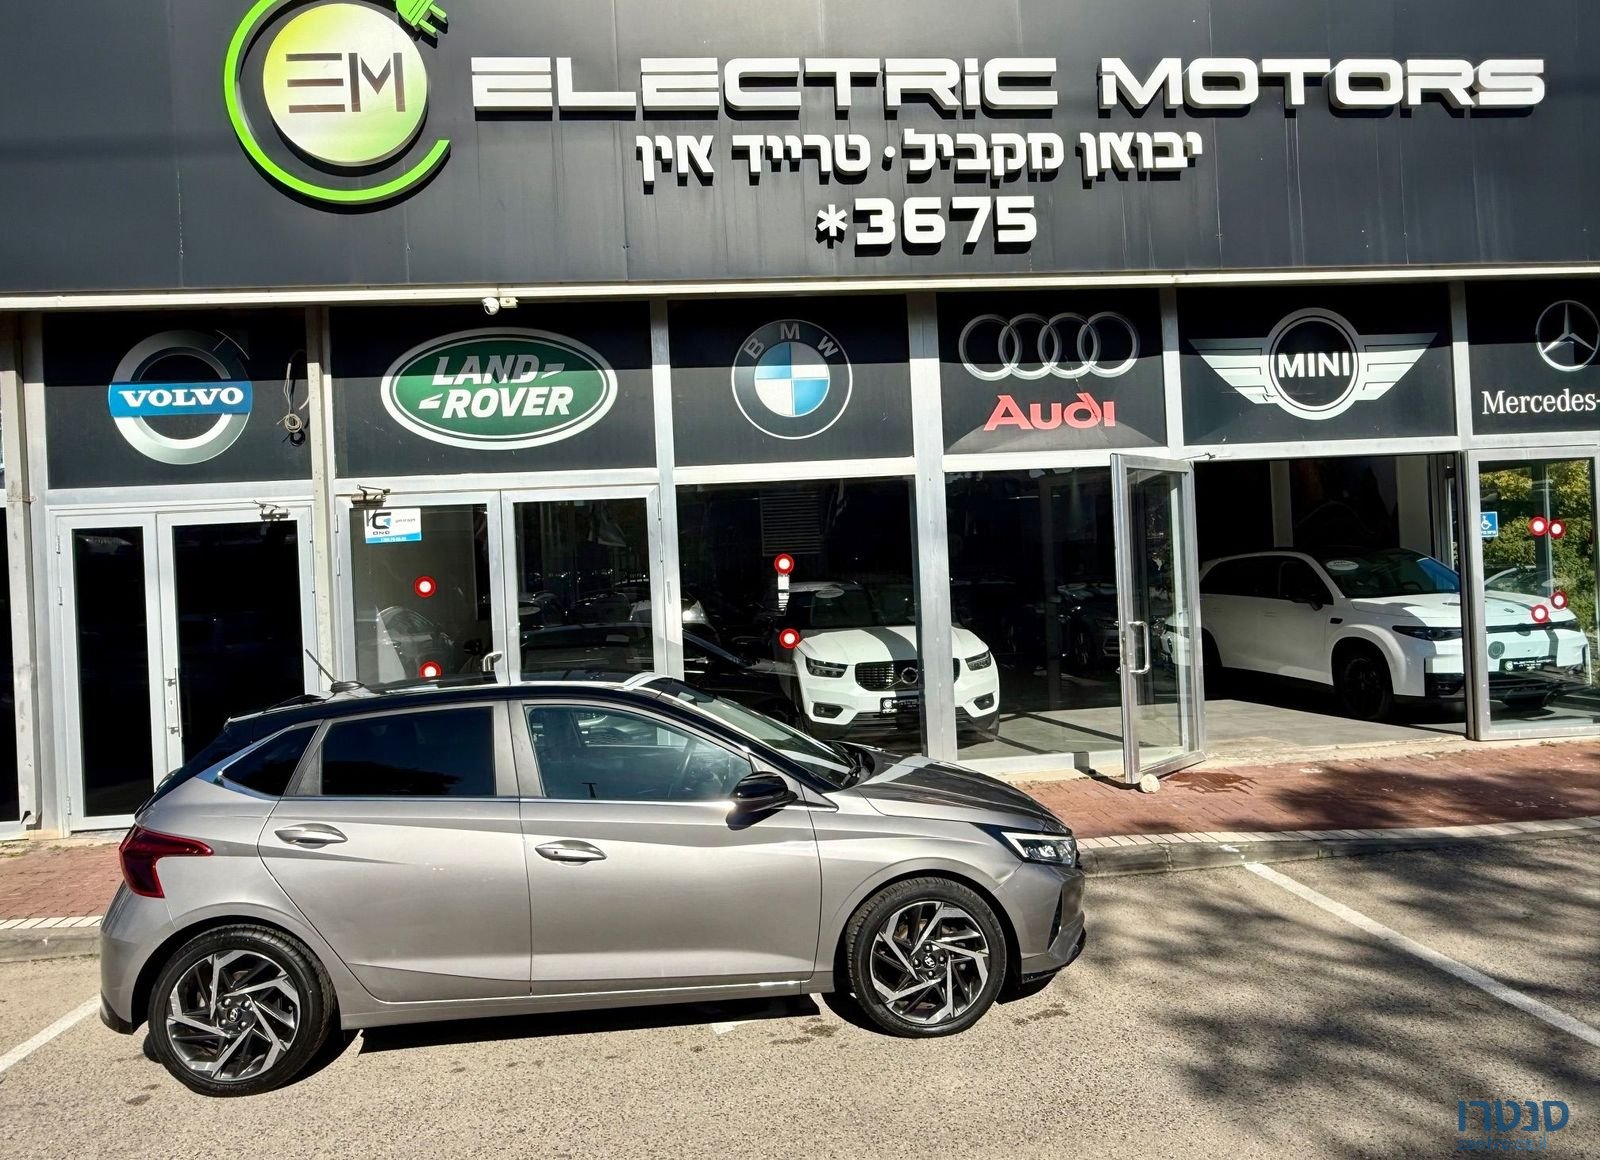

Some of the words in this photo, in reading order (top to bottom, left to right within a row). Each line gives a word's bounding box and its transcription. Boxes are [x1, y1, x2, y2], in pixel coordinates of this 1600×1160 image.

[286, 52, 405, 113] EM
[471, 57, 1059, 111] ELECTRIC
[1101, 57, 1545, 109] MOTORS
[636, 135, 715, 182] אין
[731, 134, 872, 173] טרייד
[903, 128, 1065, 176] מקביל
[1080, 131, 1203, 178] יבואן
[743, 321, 840, 360] BMW
[1277, 351, 1351, 379] MINI
[117, 387, 244, 408] VOLVO
[441, 386, 574, 419] ROVER
[983, 392, 1116, 431] Audi
